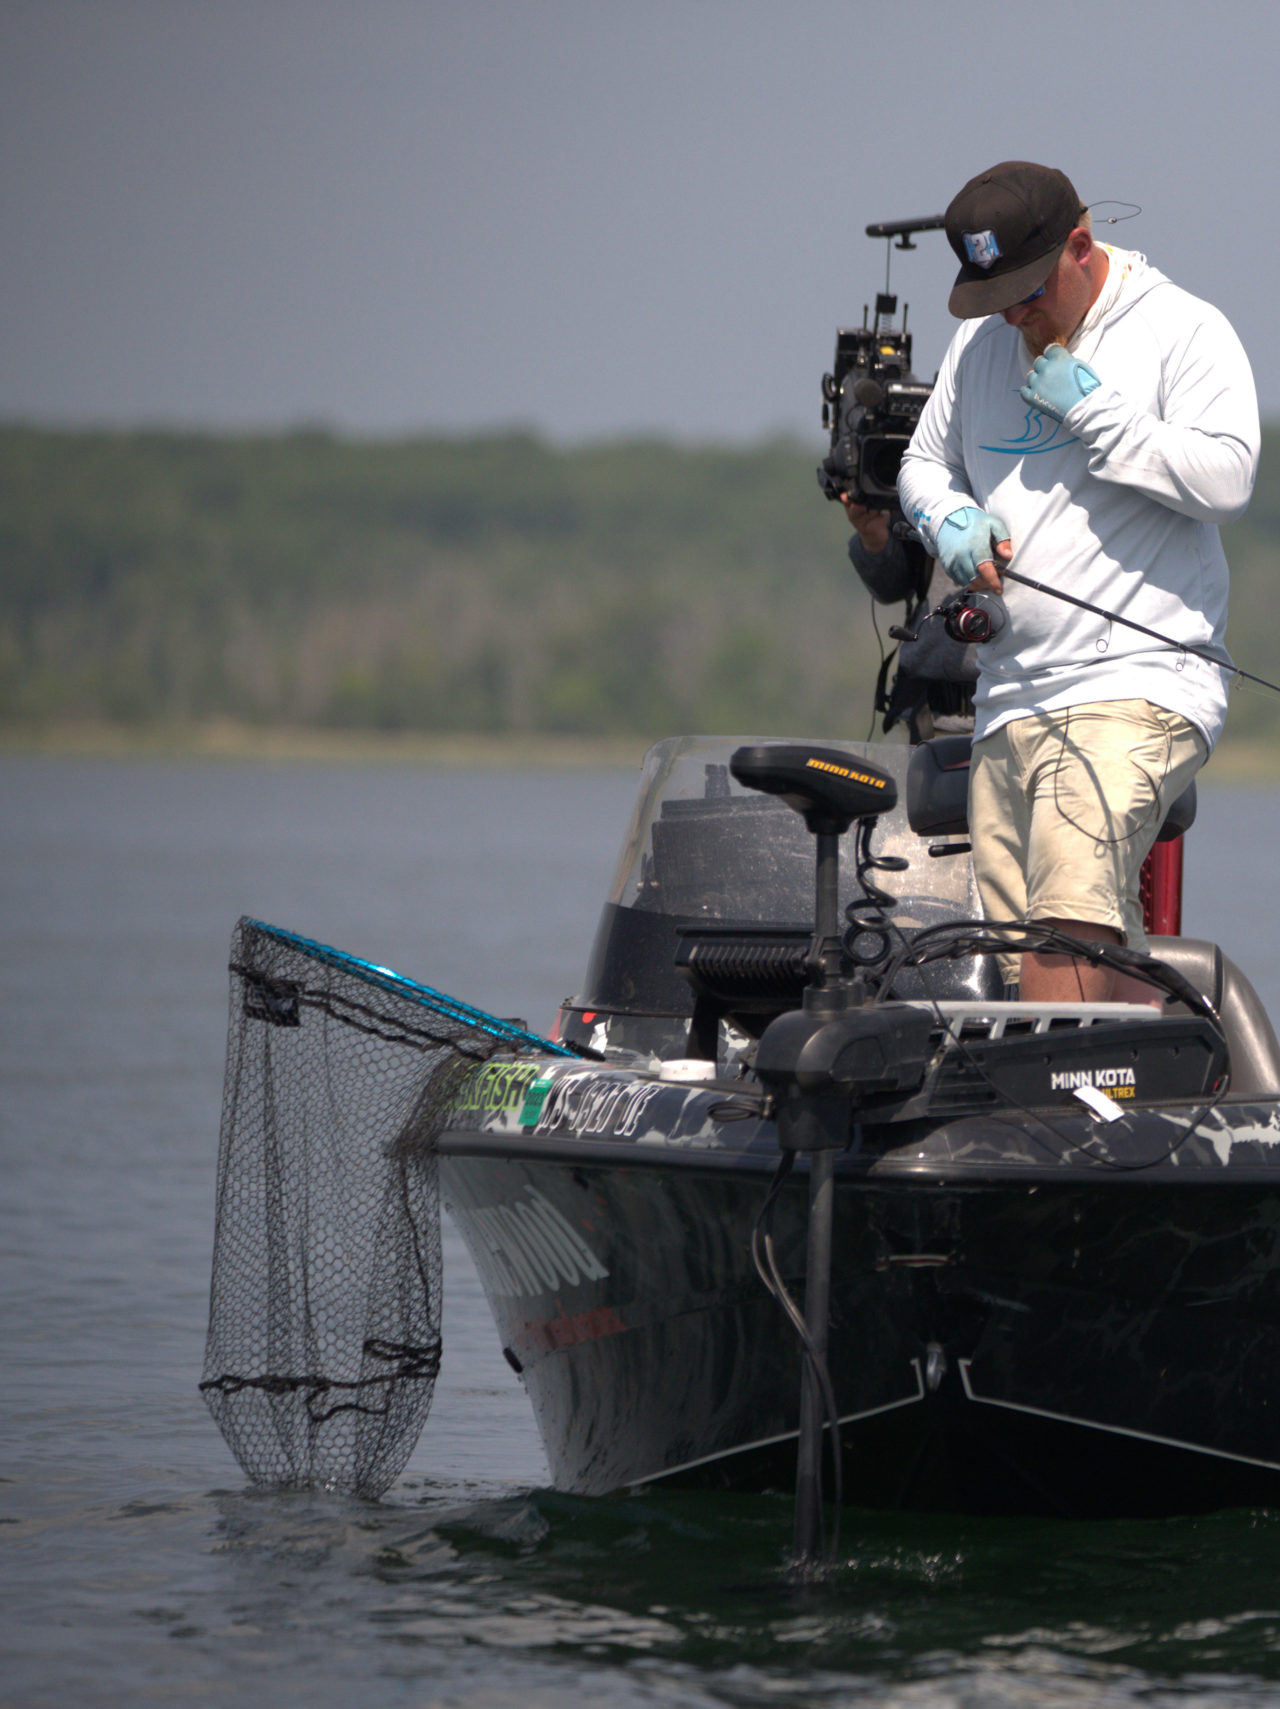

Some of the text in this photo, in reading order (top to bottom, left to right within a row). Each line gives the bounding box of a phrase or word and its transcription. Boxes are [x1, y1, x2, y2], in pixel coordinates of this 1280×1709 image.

[806, 758, 886, 789] MINN KOTA
[1051, 1068, 1136, 1090] MINN KOTA
